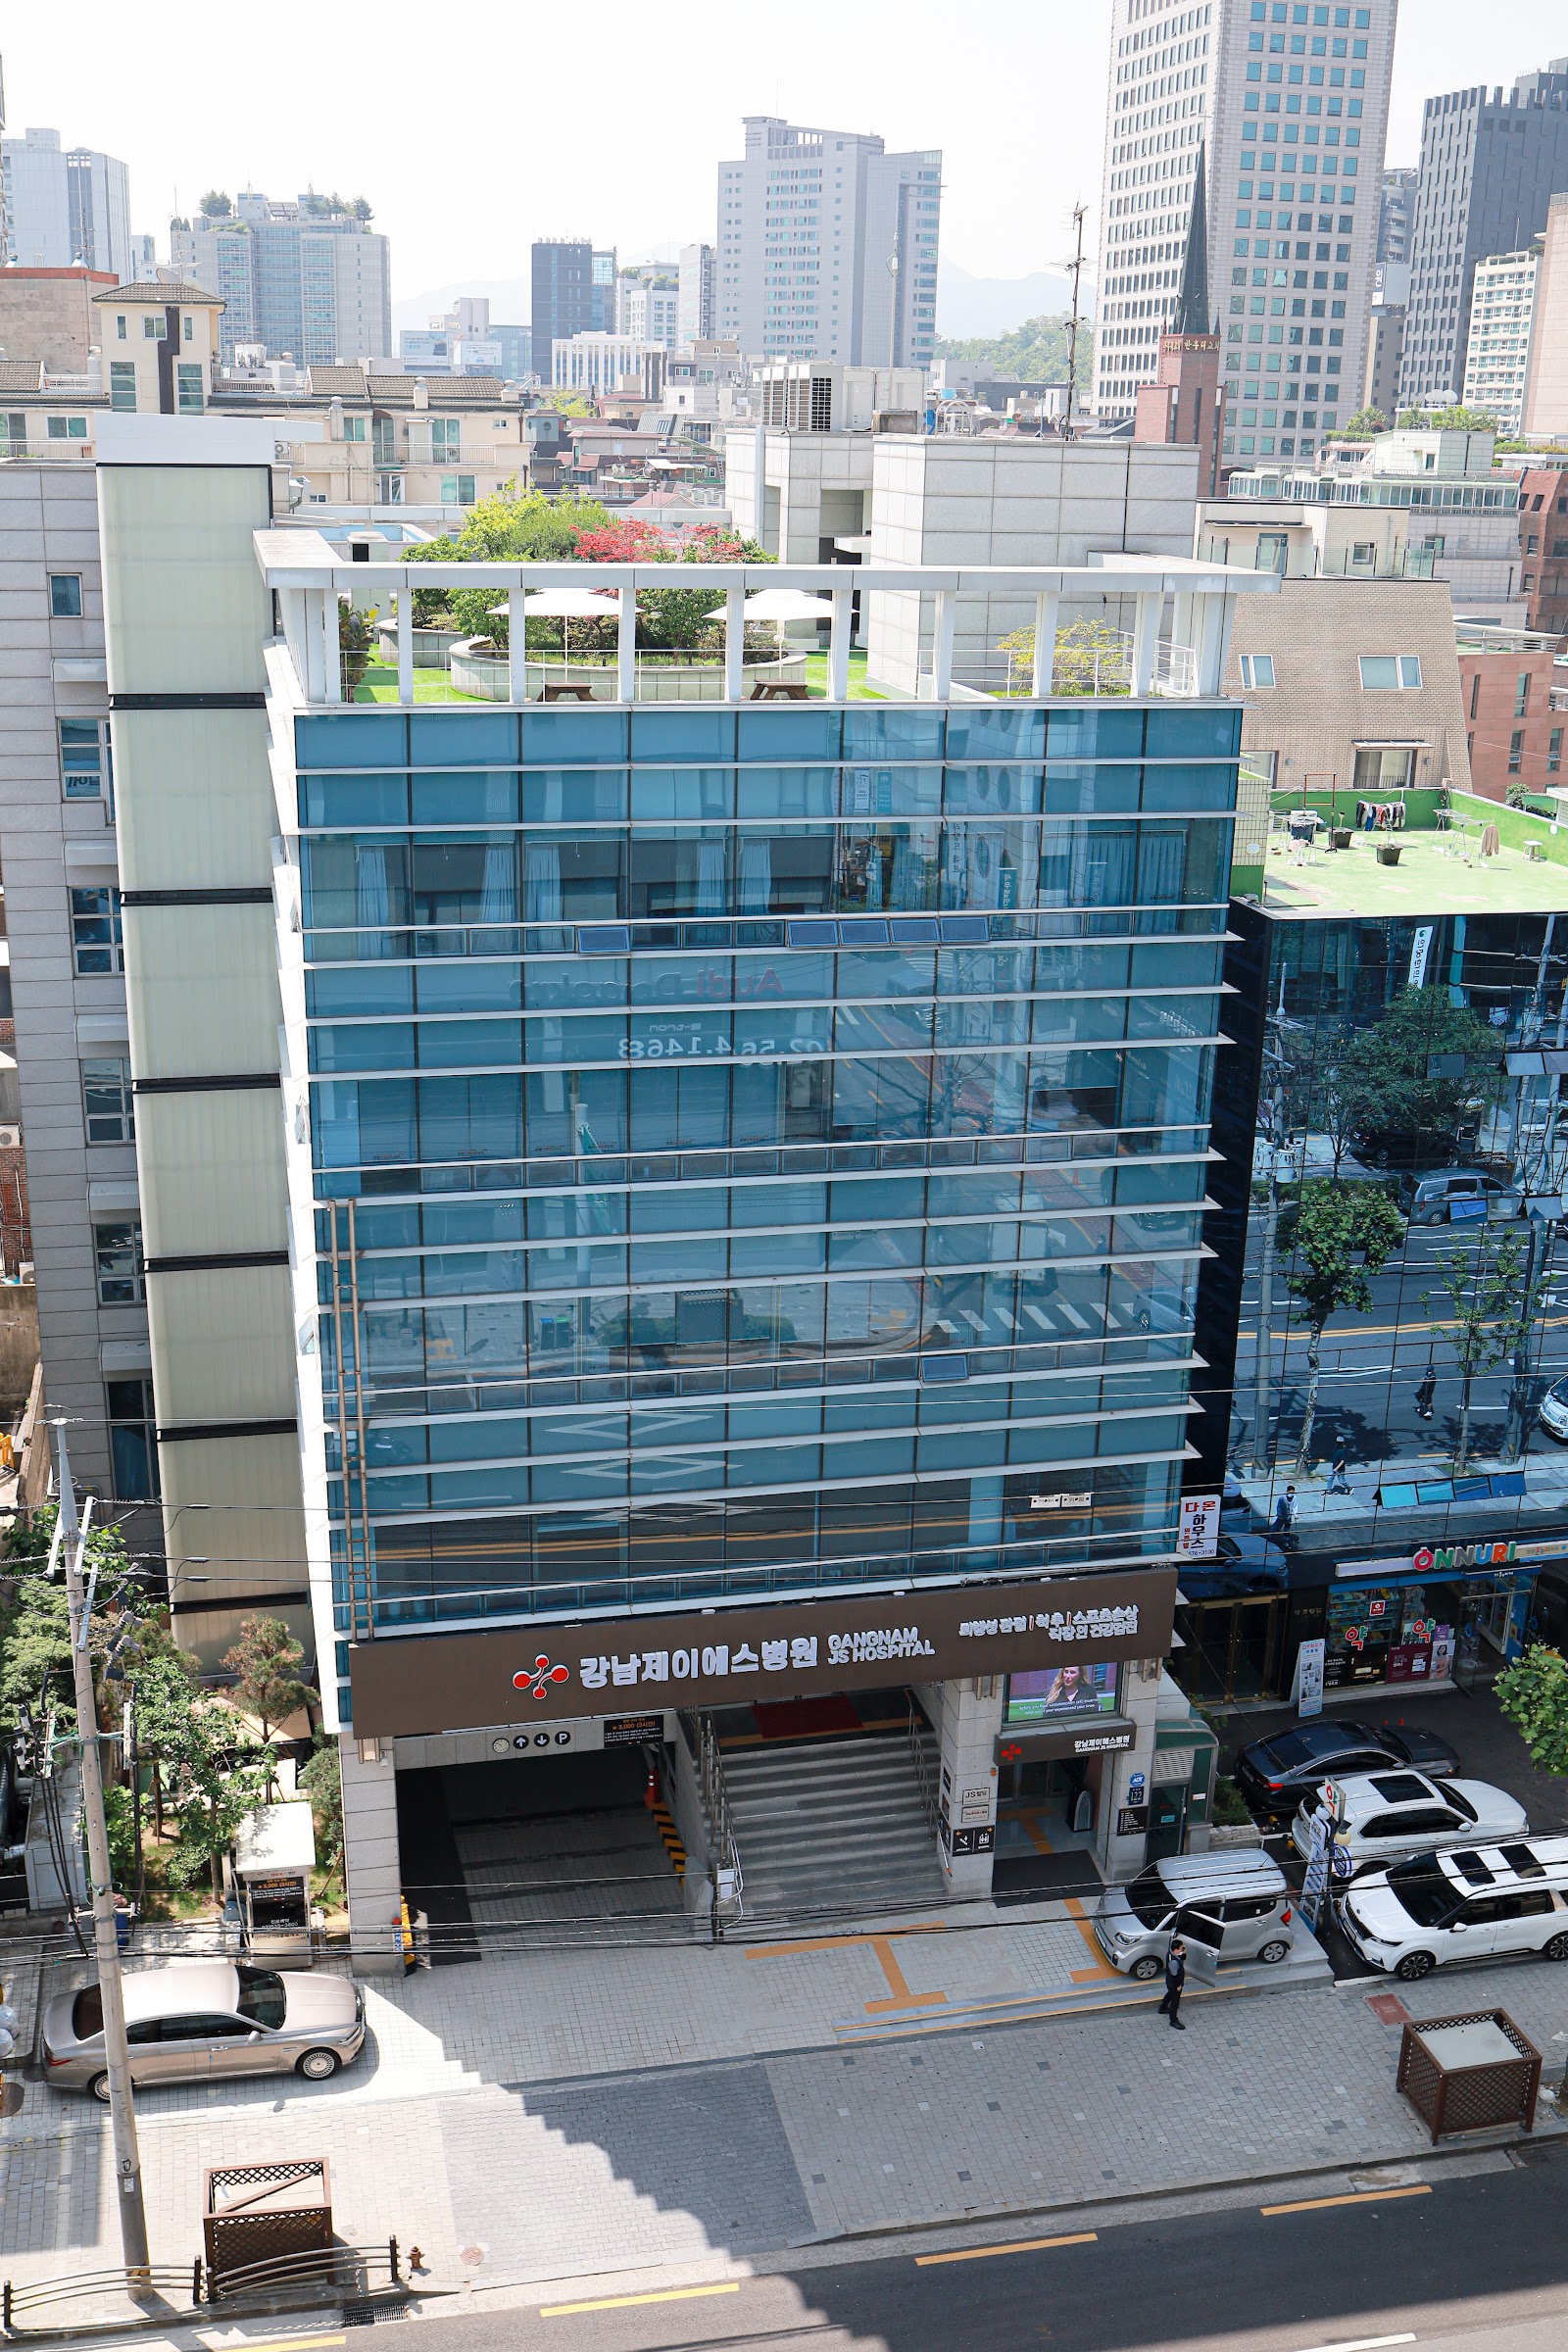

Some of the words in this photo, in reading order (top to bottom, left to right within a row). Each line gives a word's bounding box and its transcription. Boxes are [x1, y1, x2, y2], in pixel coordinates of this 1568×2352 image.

[1412, 1541, 1517, 1572] ONNURI
[827, 1626, 919, 1651] GANGNAM
[1346, 1626, 1368, 1650] 약
[1412, 1618, 1437, 1643] 약
[579, 1635, 818, 1690] 강남제이에스병원
[827, 1648, 850, 1665] JS
[852, 1639, 936, 1663] HOSPITAL
[560, 1733, 568, 1743] P
[1074, 1735, 1131, 1748] 강남제이에스병원
[1130, 1790, 1143, 1801] 122
[1326, 1785, 1338, 1815] 약
